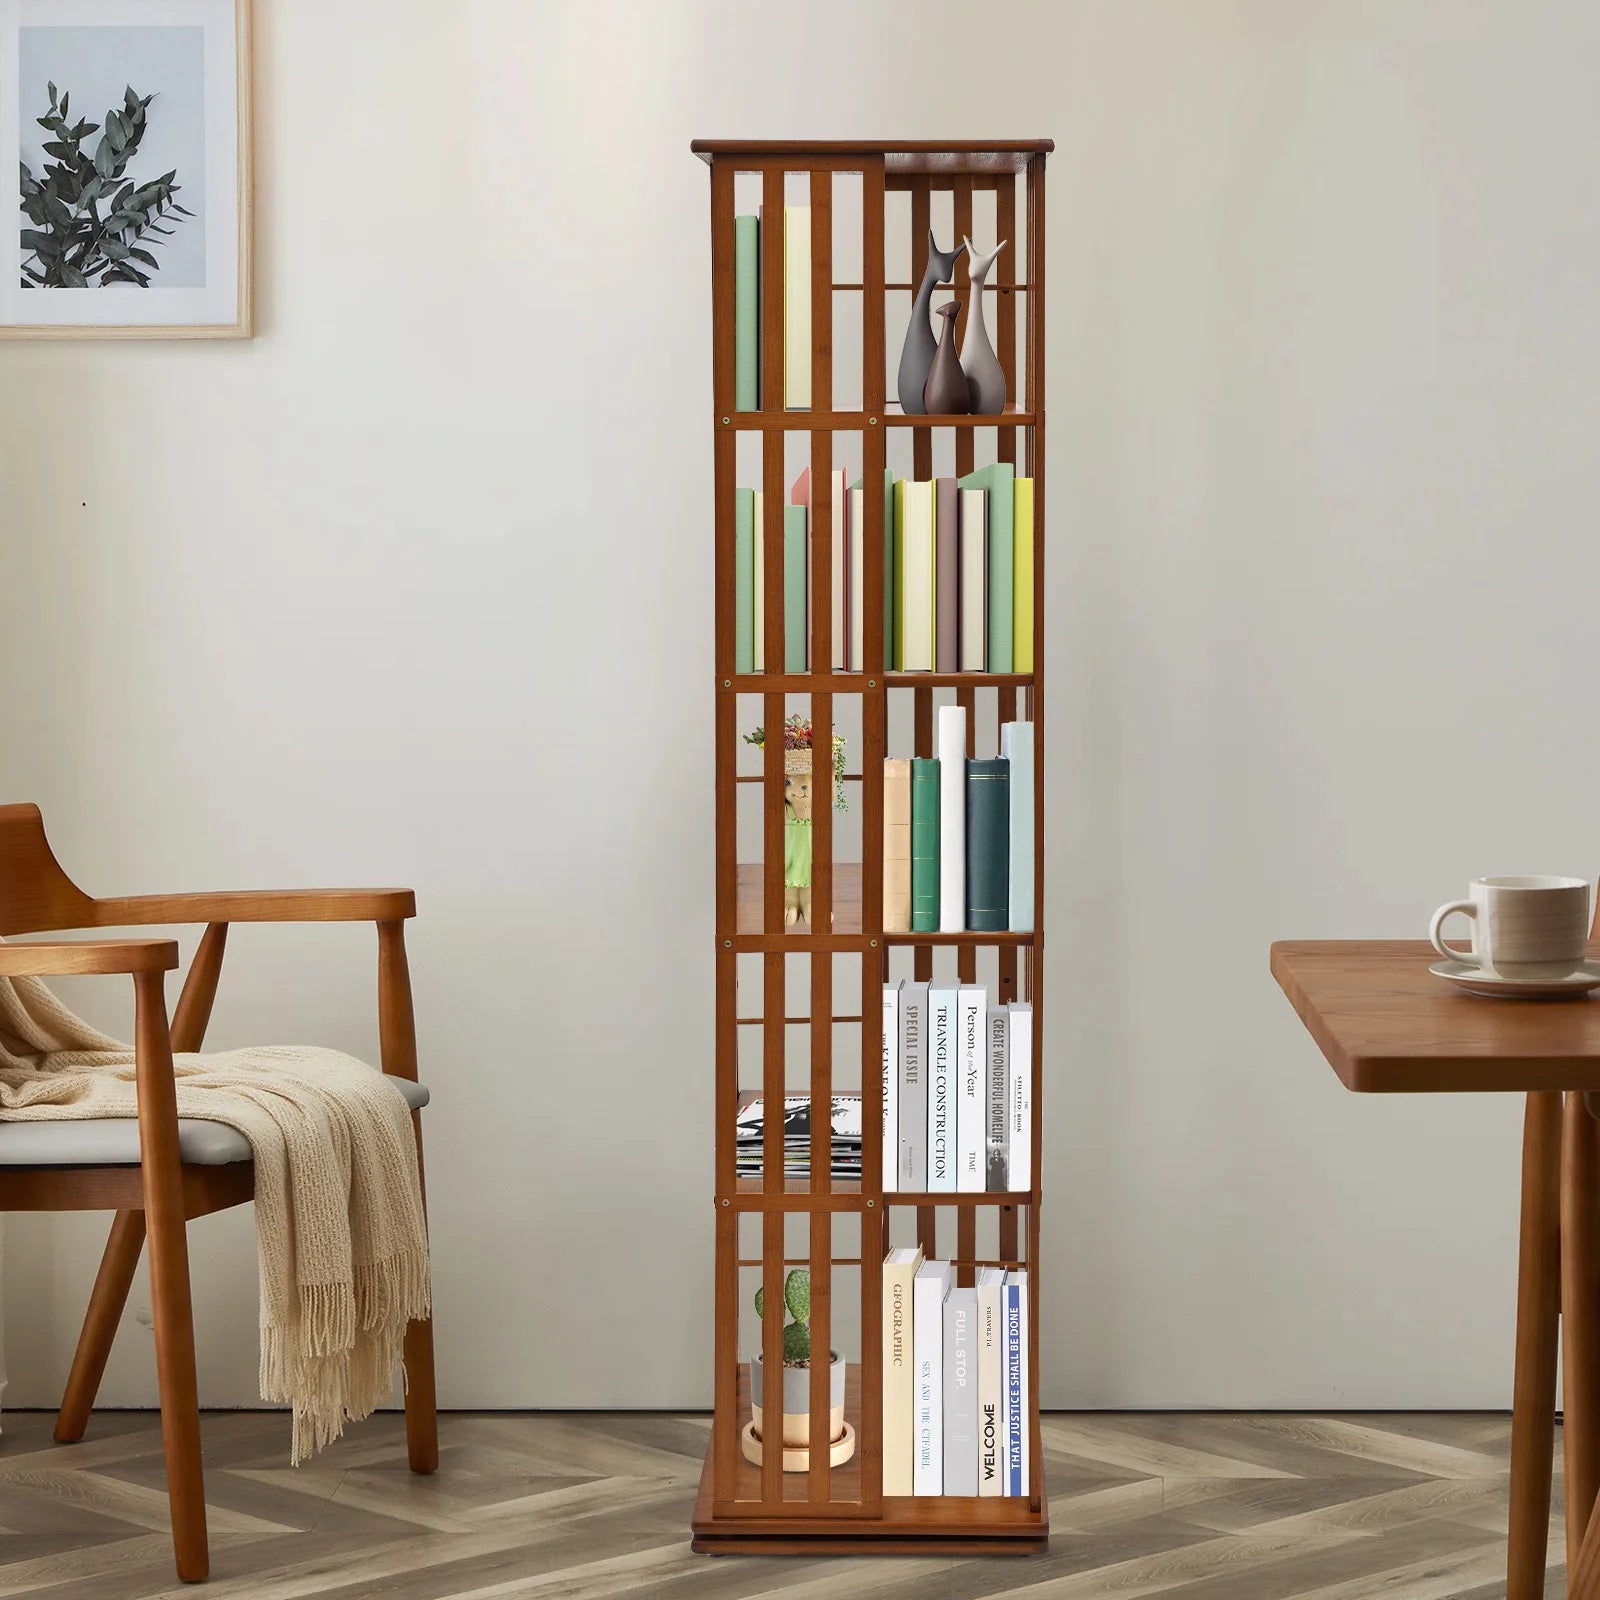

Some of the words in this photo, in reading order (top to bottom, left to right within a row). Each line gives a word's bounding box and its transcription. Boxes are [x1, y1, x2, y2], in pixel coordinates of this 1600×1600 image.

[906, 1006, 918, 1050] SPECIAL
[936, 1006, 947, 1073] TRIANGLE
[967, 1006, 978, 1049] Person
[992, 1019, 1005, 1048] CREATE
[906, 1055, 918, 1085] ISSUE
[966, 1050, 974, 1058] of
[967, 1069, 978, 1098] Year
[992, 1050, 1005, 1101] WONDERFUL
[935, 1076, 947, 1179] CONSTRUCTION
[991, 1103, 1004, 1144] HOMELIFE
[955, 1310, 966, 1346] FULL
[1009, 1307, 1019, 1336] DONE
[1010, 1338, 1019, 1352] BE
[922, 1361, 930, 1378] SEX
[955, 1349, 966, 1389] STOP.
[1010, 1353, 1019, 1386] SHALL
[921, 1383, 930, 1401] AND
[921, 1406, 930, 1424] THE
[1010, 1390, 1020, 1436] JUSTICE
[983, 1404, 995, 1481] WELCOME
[1011, 1440, 1020, 1470] THAT
